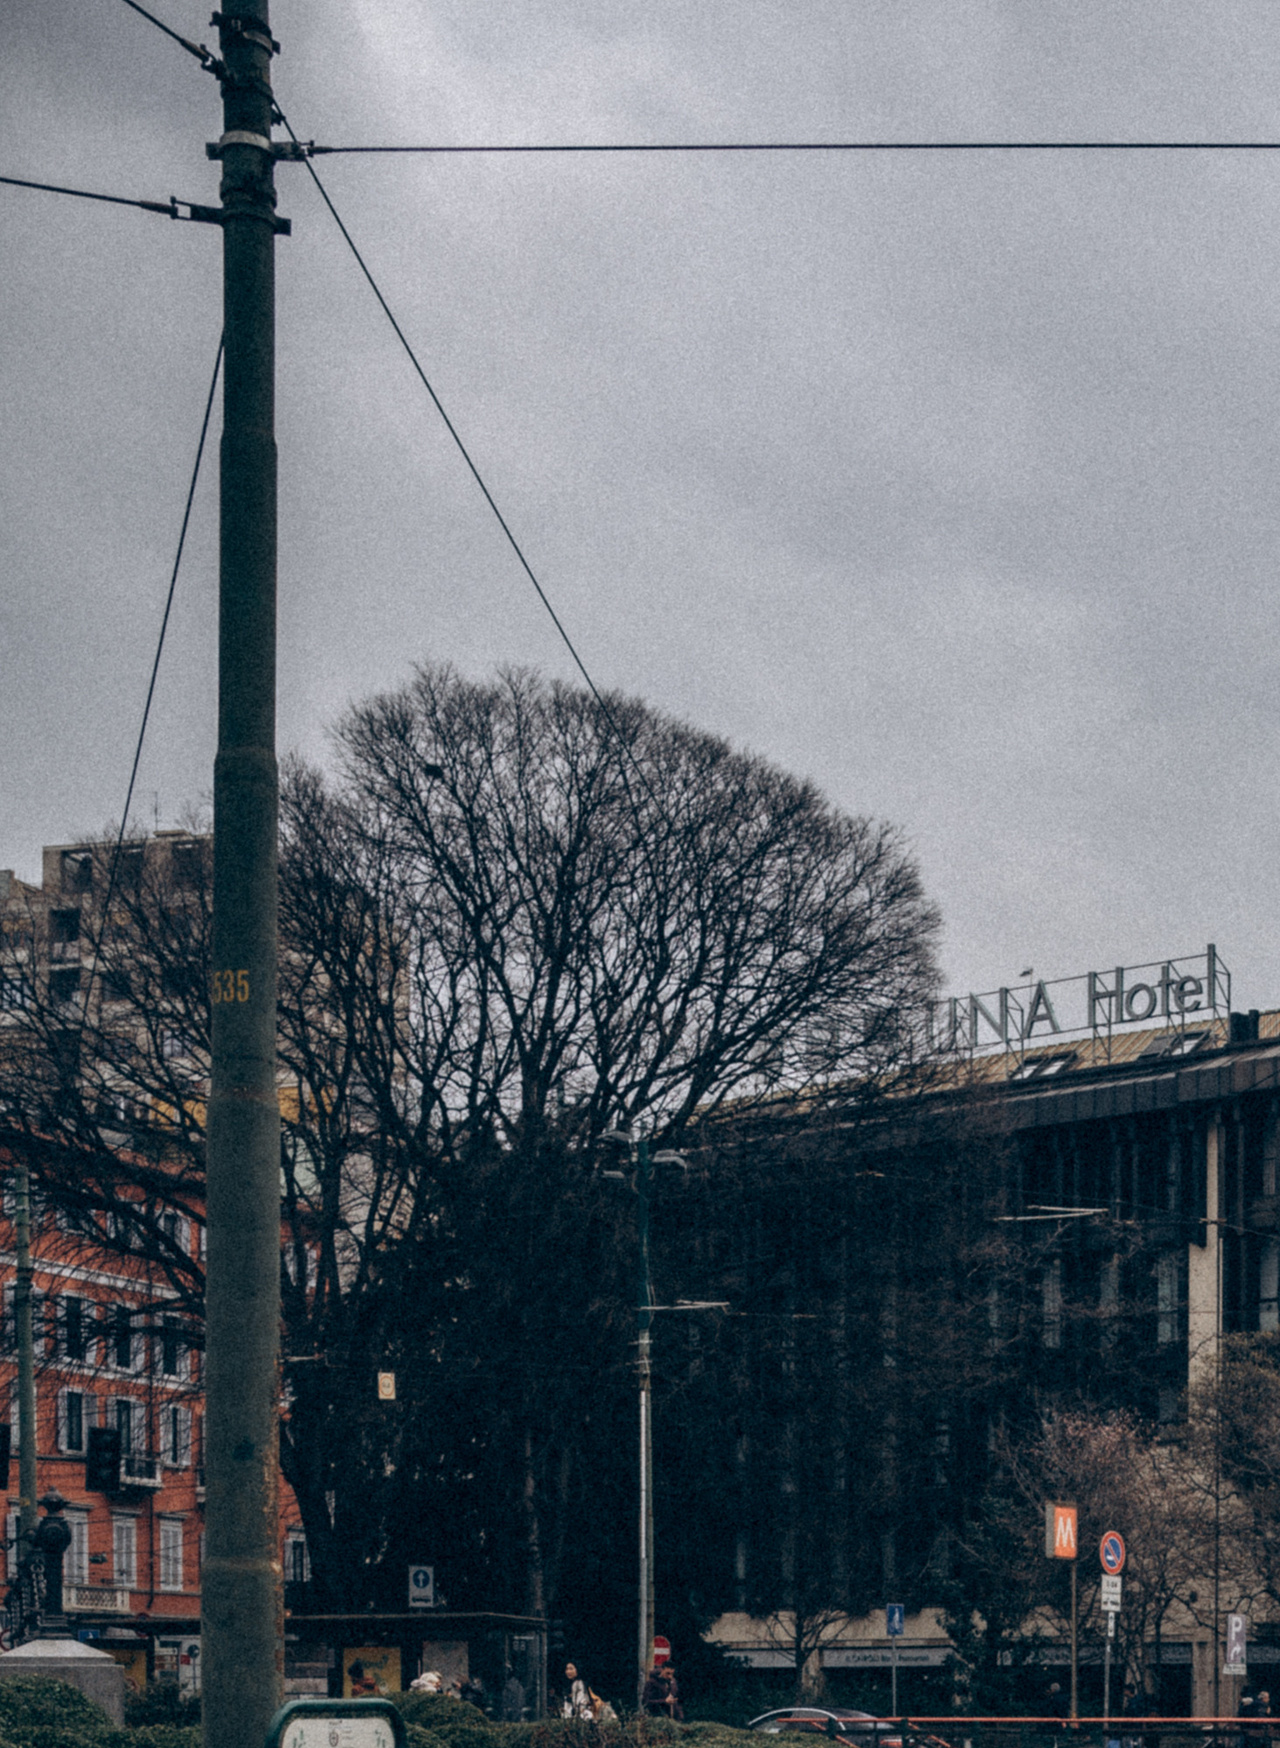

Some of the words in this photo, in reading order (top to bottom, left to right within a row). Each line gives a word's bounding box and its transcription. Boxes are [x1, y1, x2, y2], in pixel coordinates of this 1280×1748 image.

[1087, 943, 1216, 1028] Hotel
[1055, 1516, 1075, 1548] M
[1231, 1616, 1243, 1641] P
